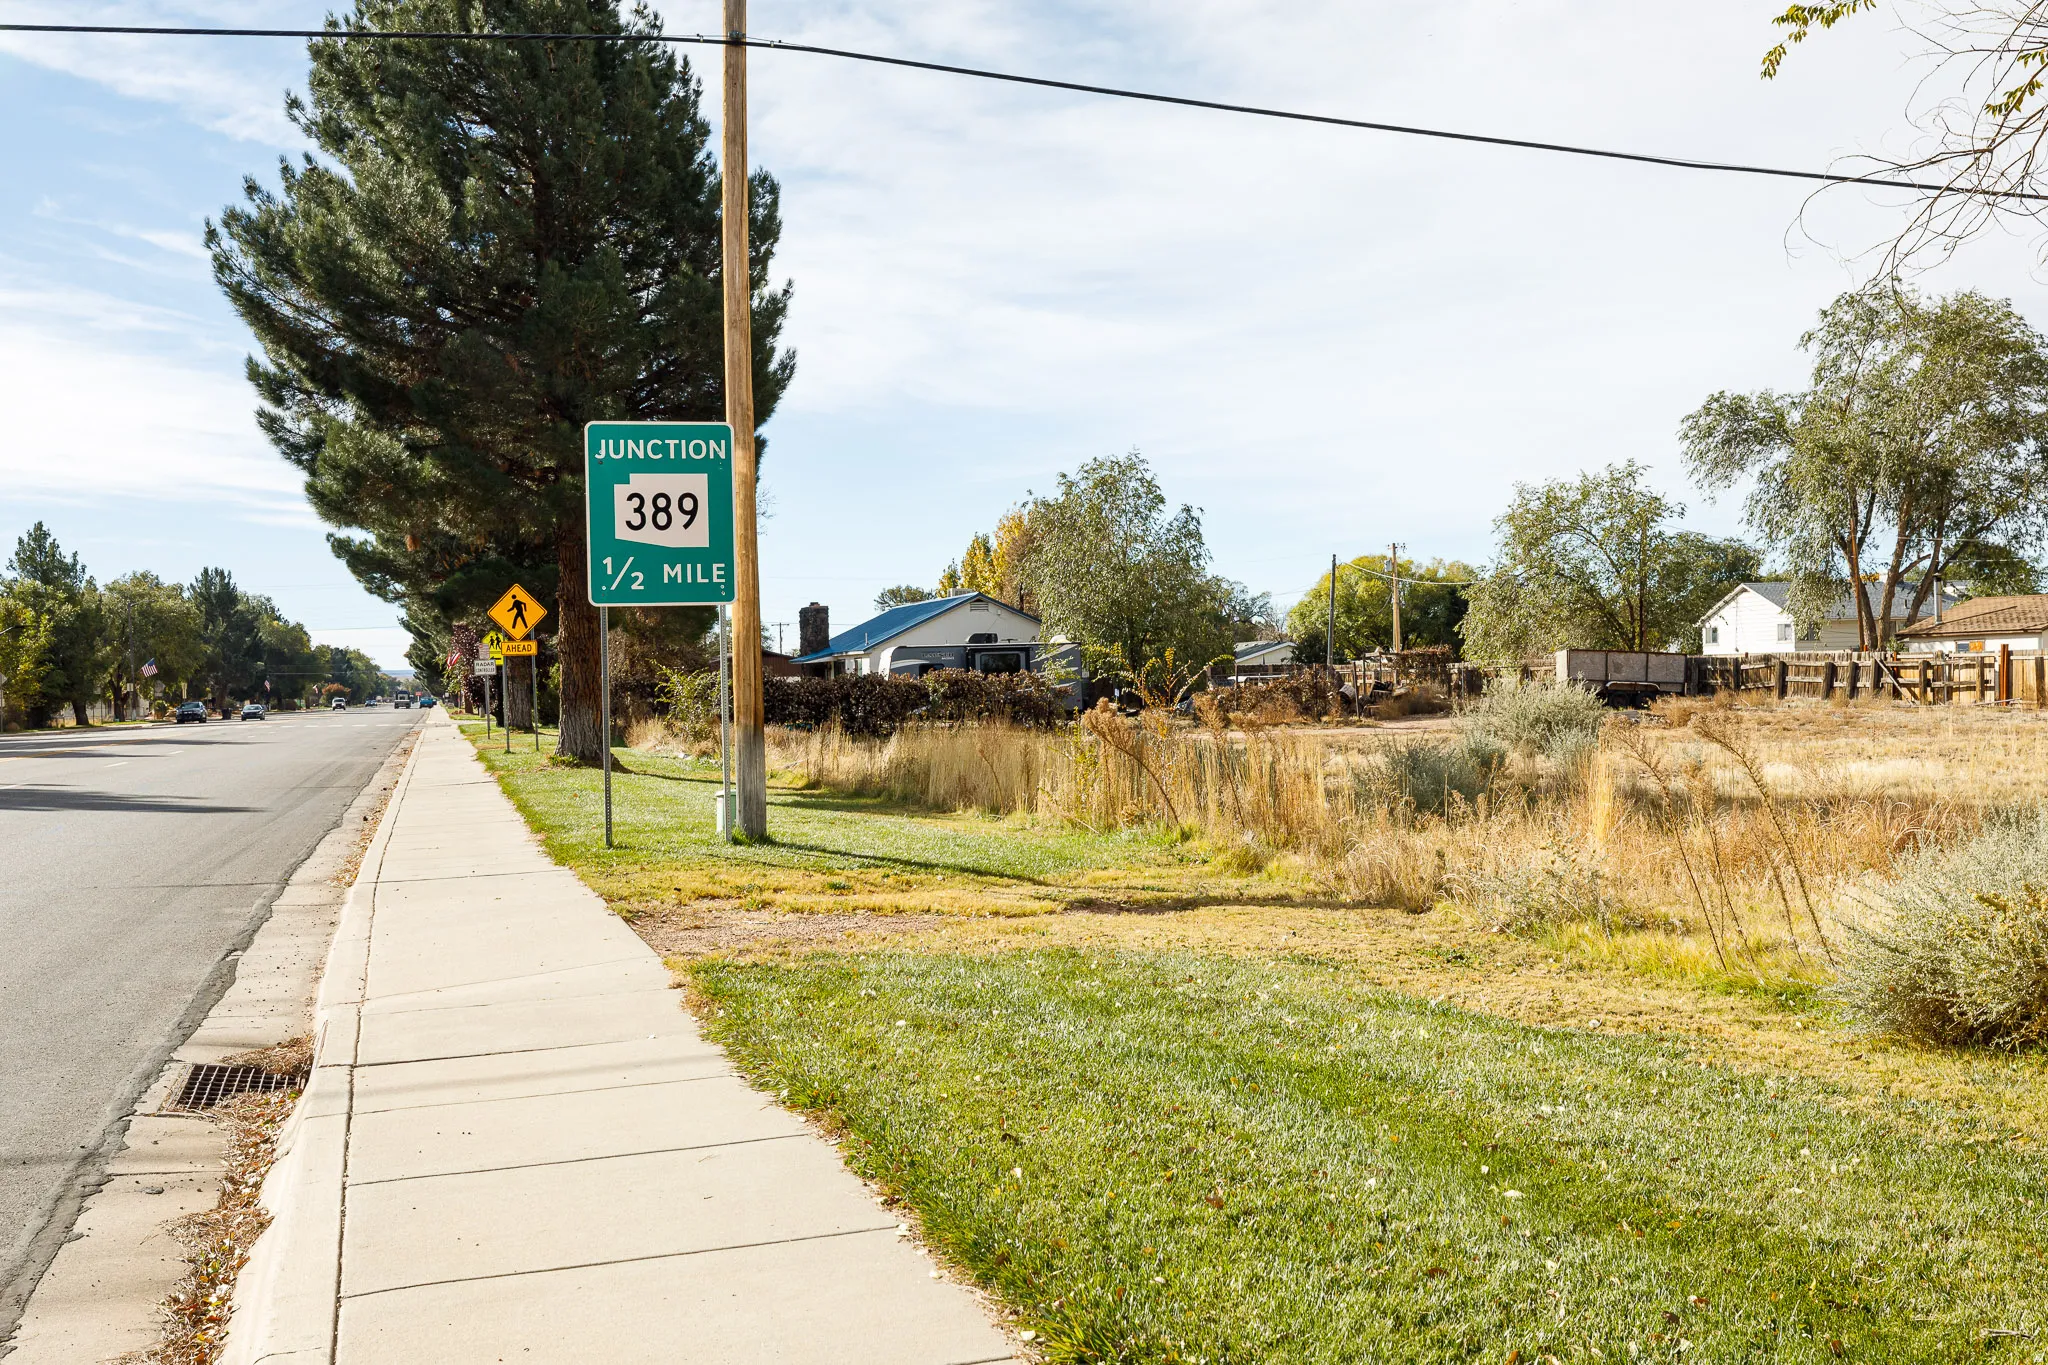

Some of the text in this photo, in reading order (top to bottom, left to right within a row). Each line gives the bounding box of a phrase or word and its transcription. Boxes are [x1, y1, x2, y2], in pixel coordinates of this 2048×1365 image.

[594, 439, 726, 459] JUNCTION
[625, 492, 699, 531] 389
[602, 556, 726, 590] 1/2 MILE
[506, 644, 532, 653] AHEAD
